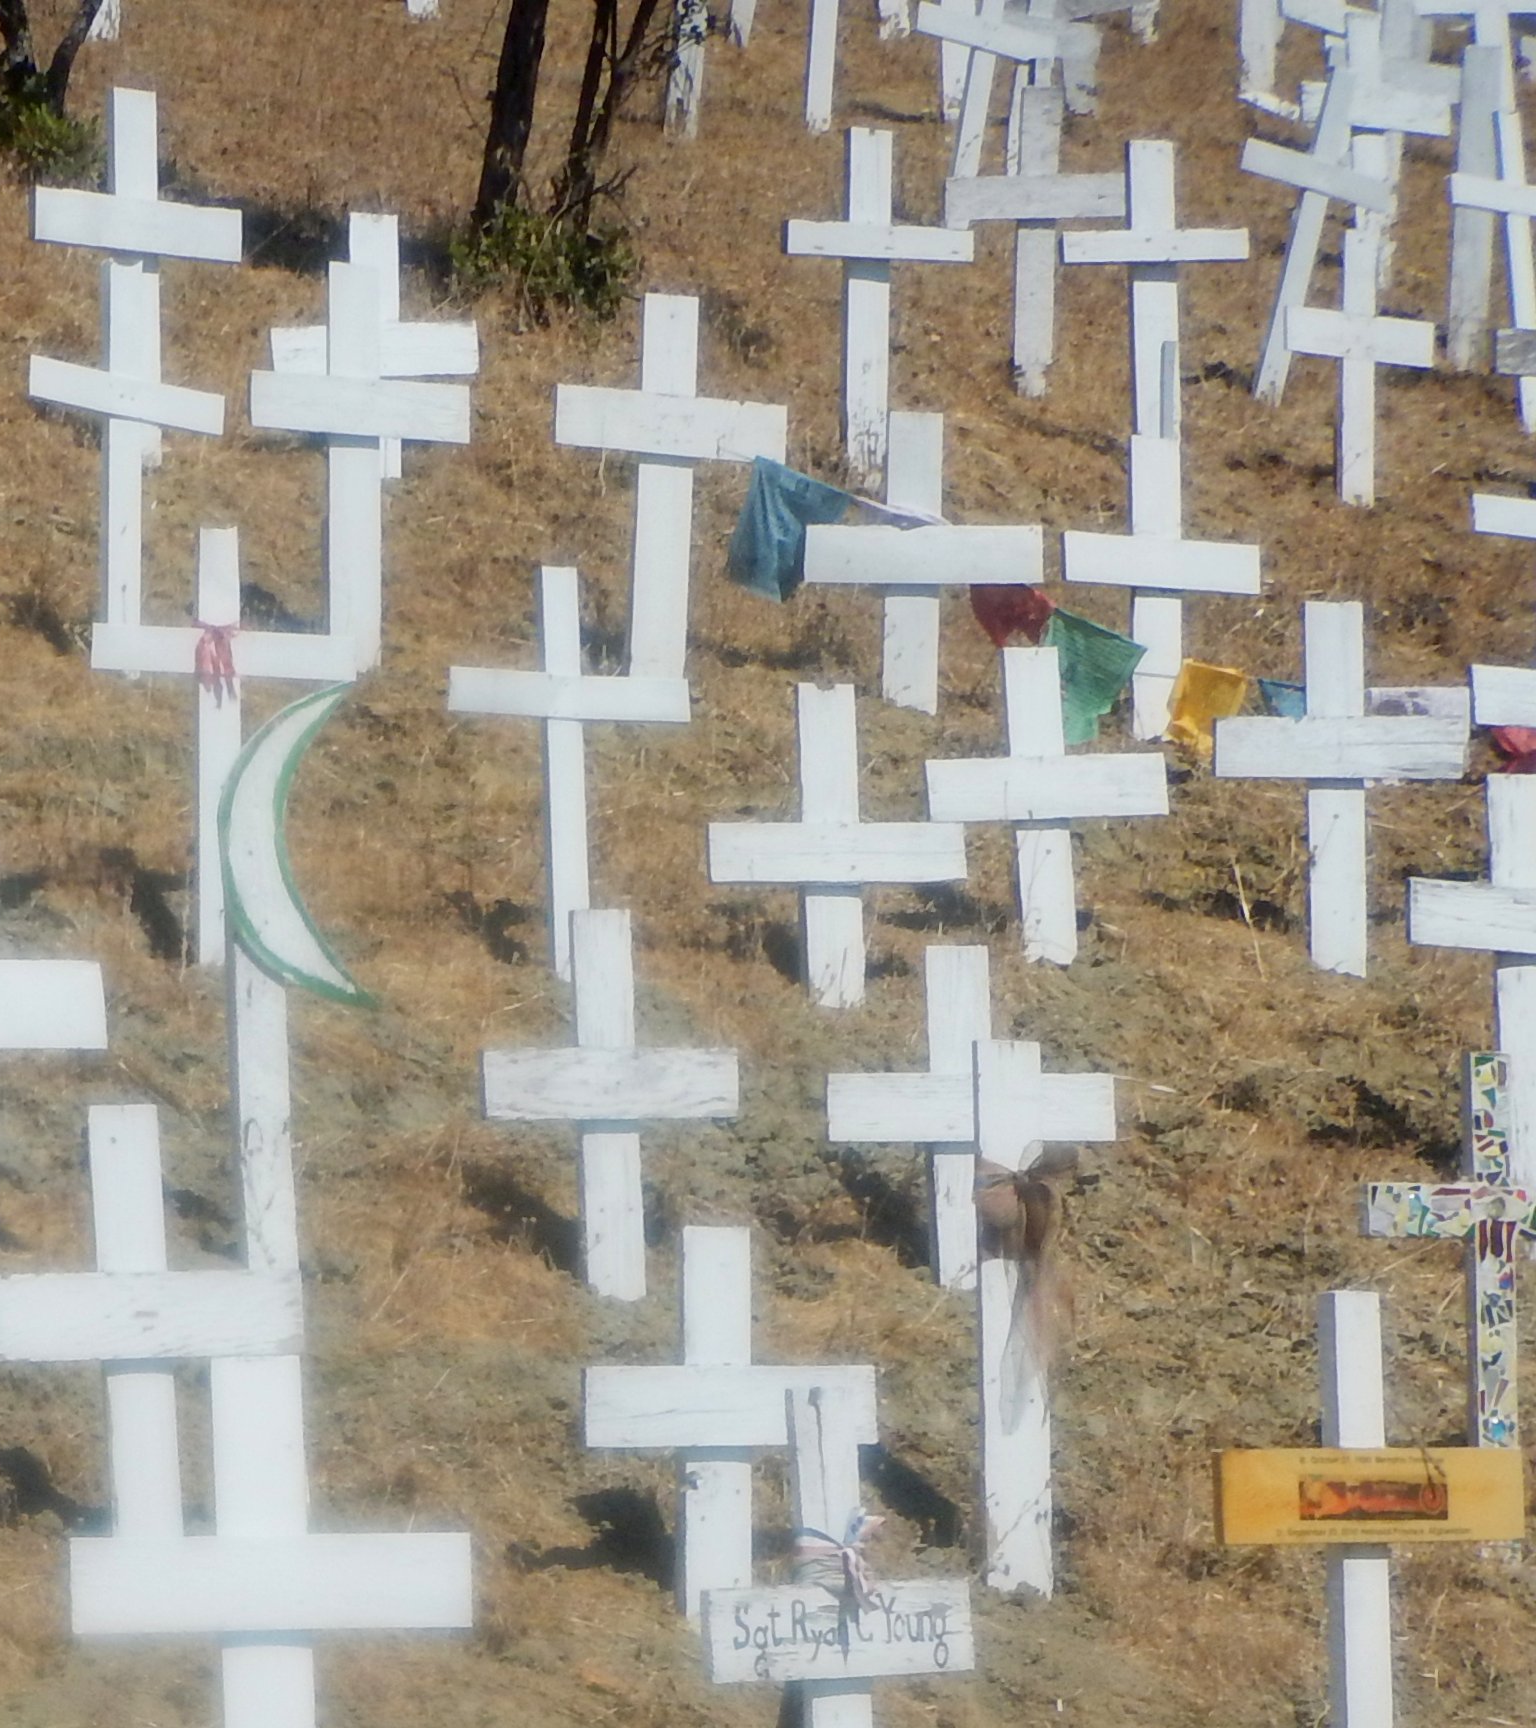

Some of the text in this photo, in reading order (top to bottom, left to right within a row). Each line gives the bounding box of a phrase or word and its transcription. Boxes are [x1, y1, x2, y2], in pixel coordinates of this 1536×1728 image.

[733, 1600, 785, 1678] Sgt
[790, 1599, 849, 1662] Rya
[875, 1592, 958, 1669] Young
